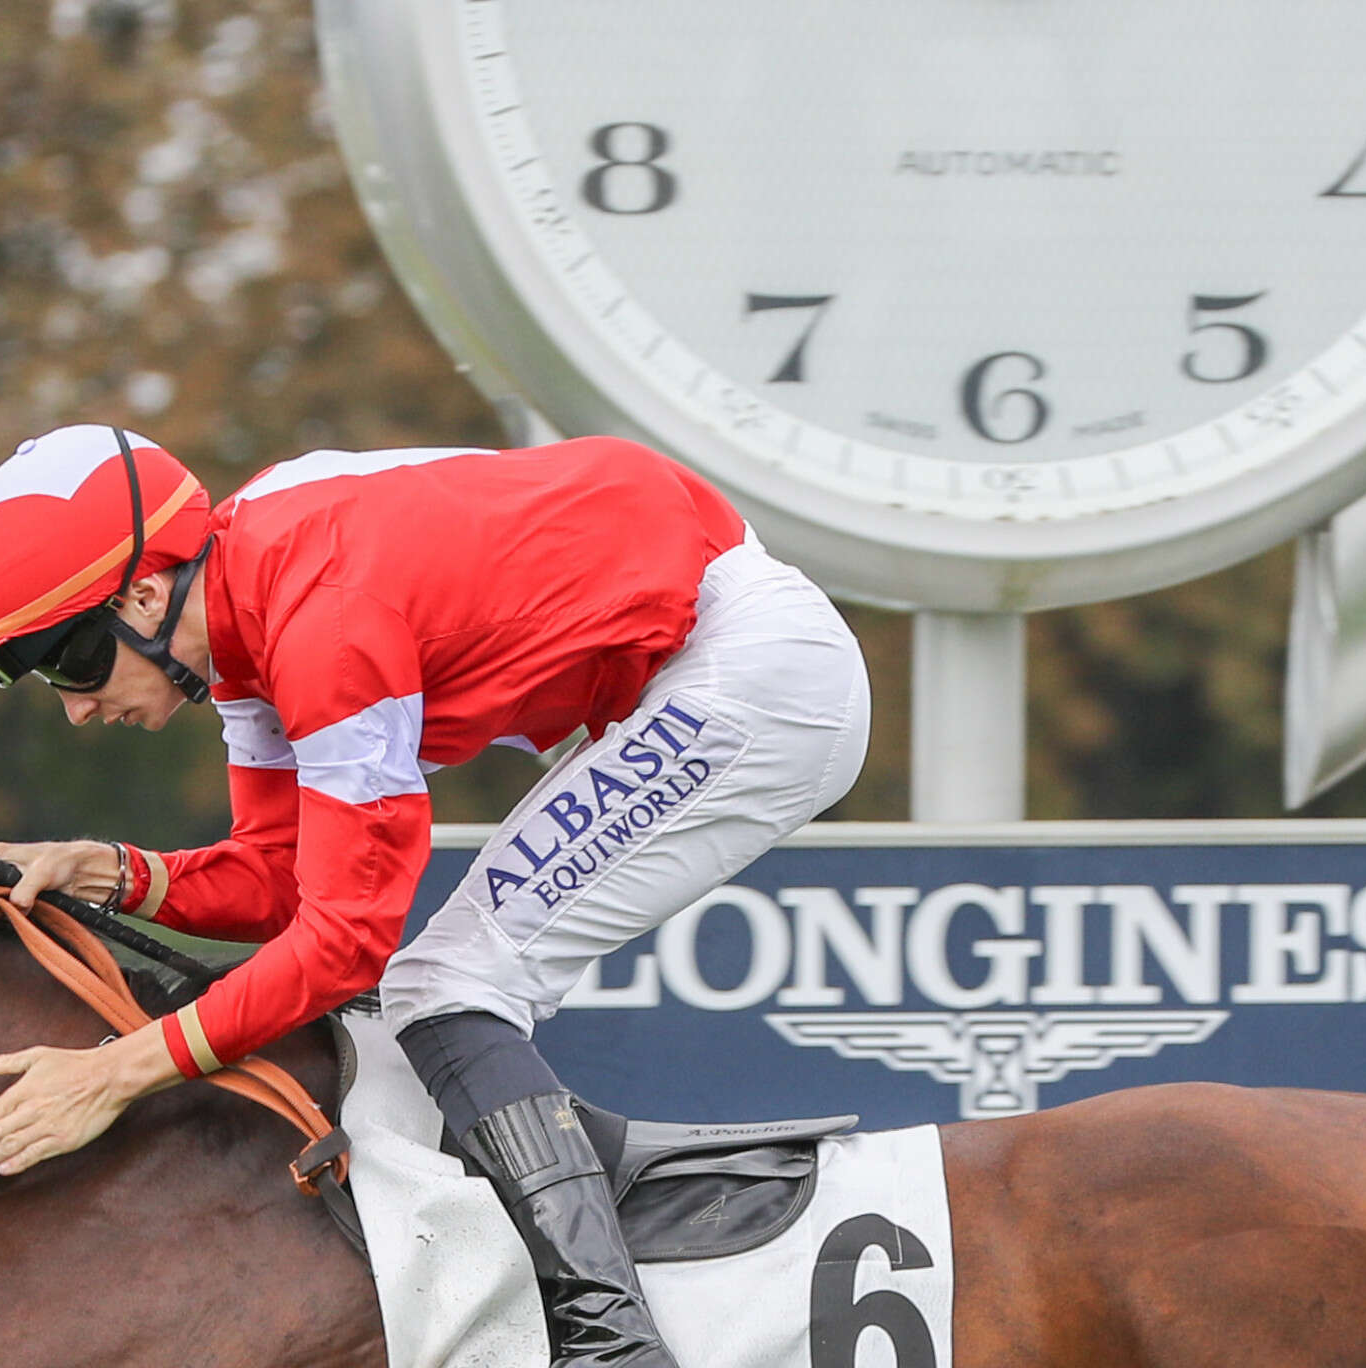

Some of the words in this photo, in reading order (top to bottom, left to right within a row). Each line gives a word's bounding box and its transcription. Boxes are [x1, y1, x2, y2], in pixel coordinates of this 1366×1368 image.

[581, 121, 676, 216] 8
[895, 148, 1122, 177] AUTOMATIC
[741, 291, 837, 384] 7
[1180, 289, 1271, 384] 5
[958, 350, 1050, 445] 6
[484, 700, 708, 912] ALBASTI
[532, 758, 711, 910] EQUIWORLD
